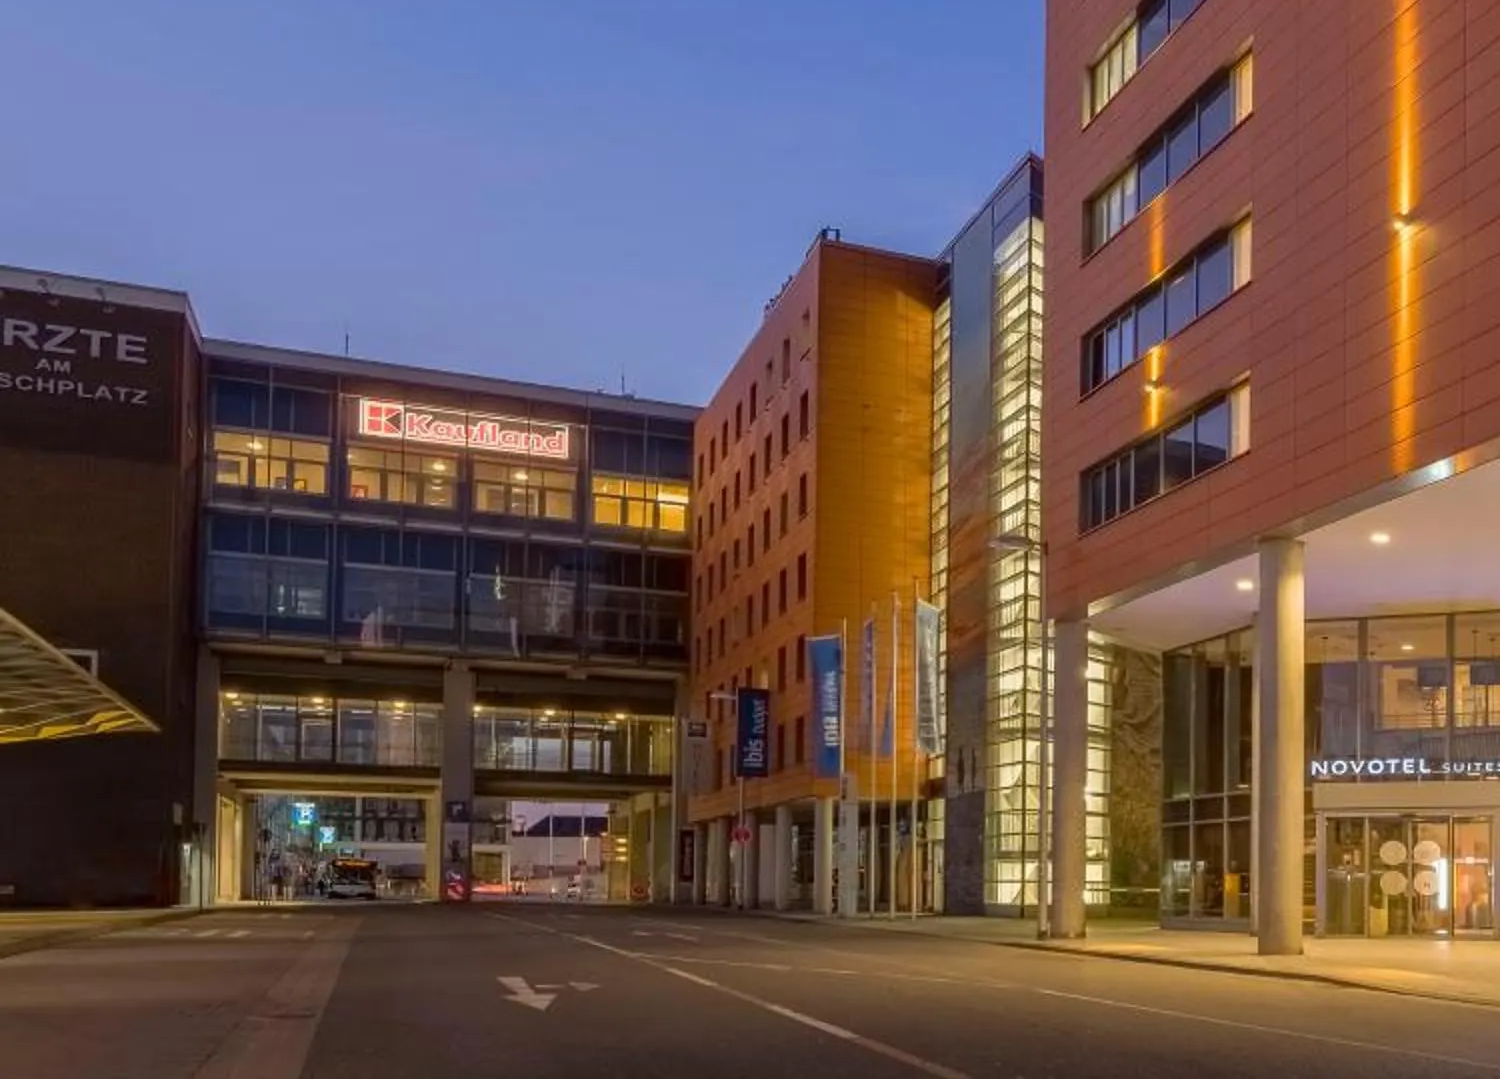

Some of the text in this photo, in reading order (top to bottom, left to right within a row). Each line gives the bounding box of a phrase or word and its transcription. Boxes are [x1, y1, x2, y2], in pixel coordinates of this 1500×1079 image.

[35, 358, 72, 374] AM
[405, 412, 568, 457] Kaufland
[1311, 758, 1432, 776] NOVOTEL
